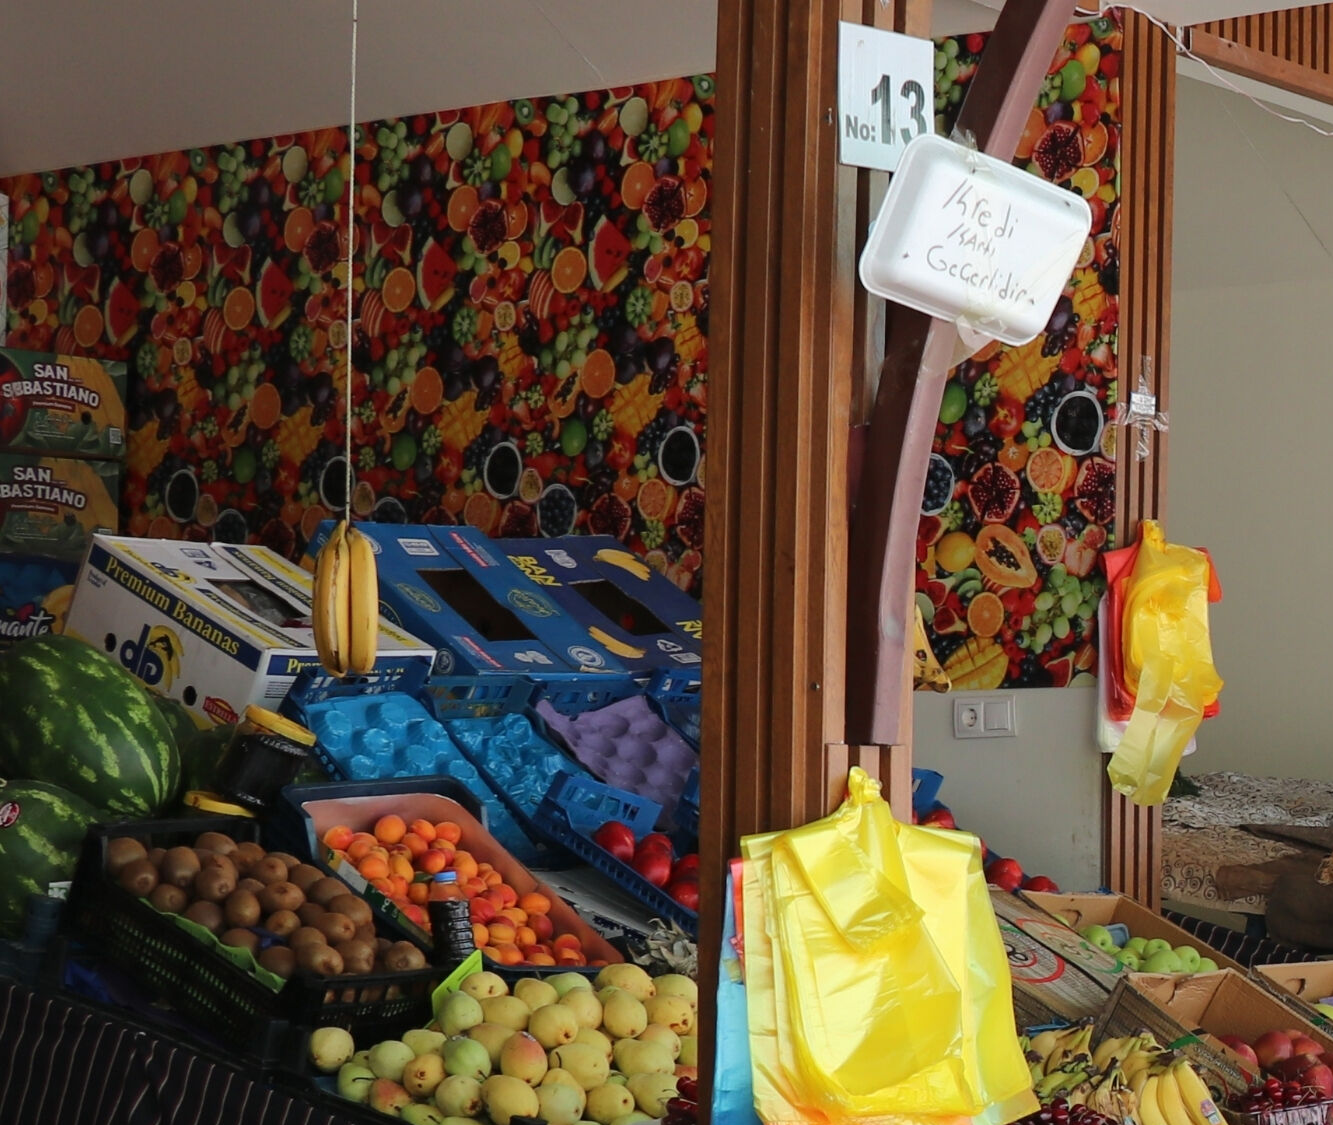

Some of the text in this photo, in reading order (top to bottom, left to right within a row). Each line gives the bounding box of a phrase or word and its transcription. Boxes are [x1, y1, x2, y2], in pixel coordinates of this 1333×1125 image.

[845, 74, 927, 147] No: 13
[942, 177, 1019, 239] Kredi
[33, 363, 69, 381] SAN
[0, 483, 87, 509] BASTIANO
[13, 466, 52, 483] SAN
[104, 556, 240, 656] Premium Bananas
